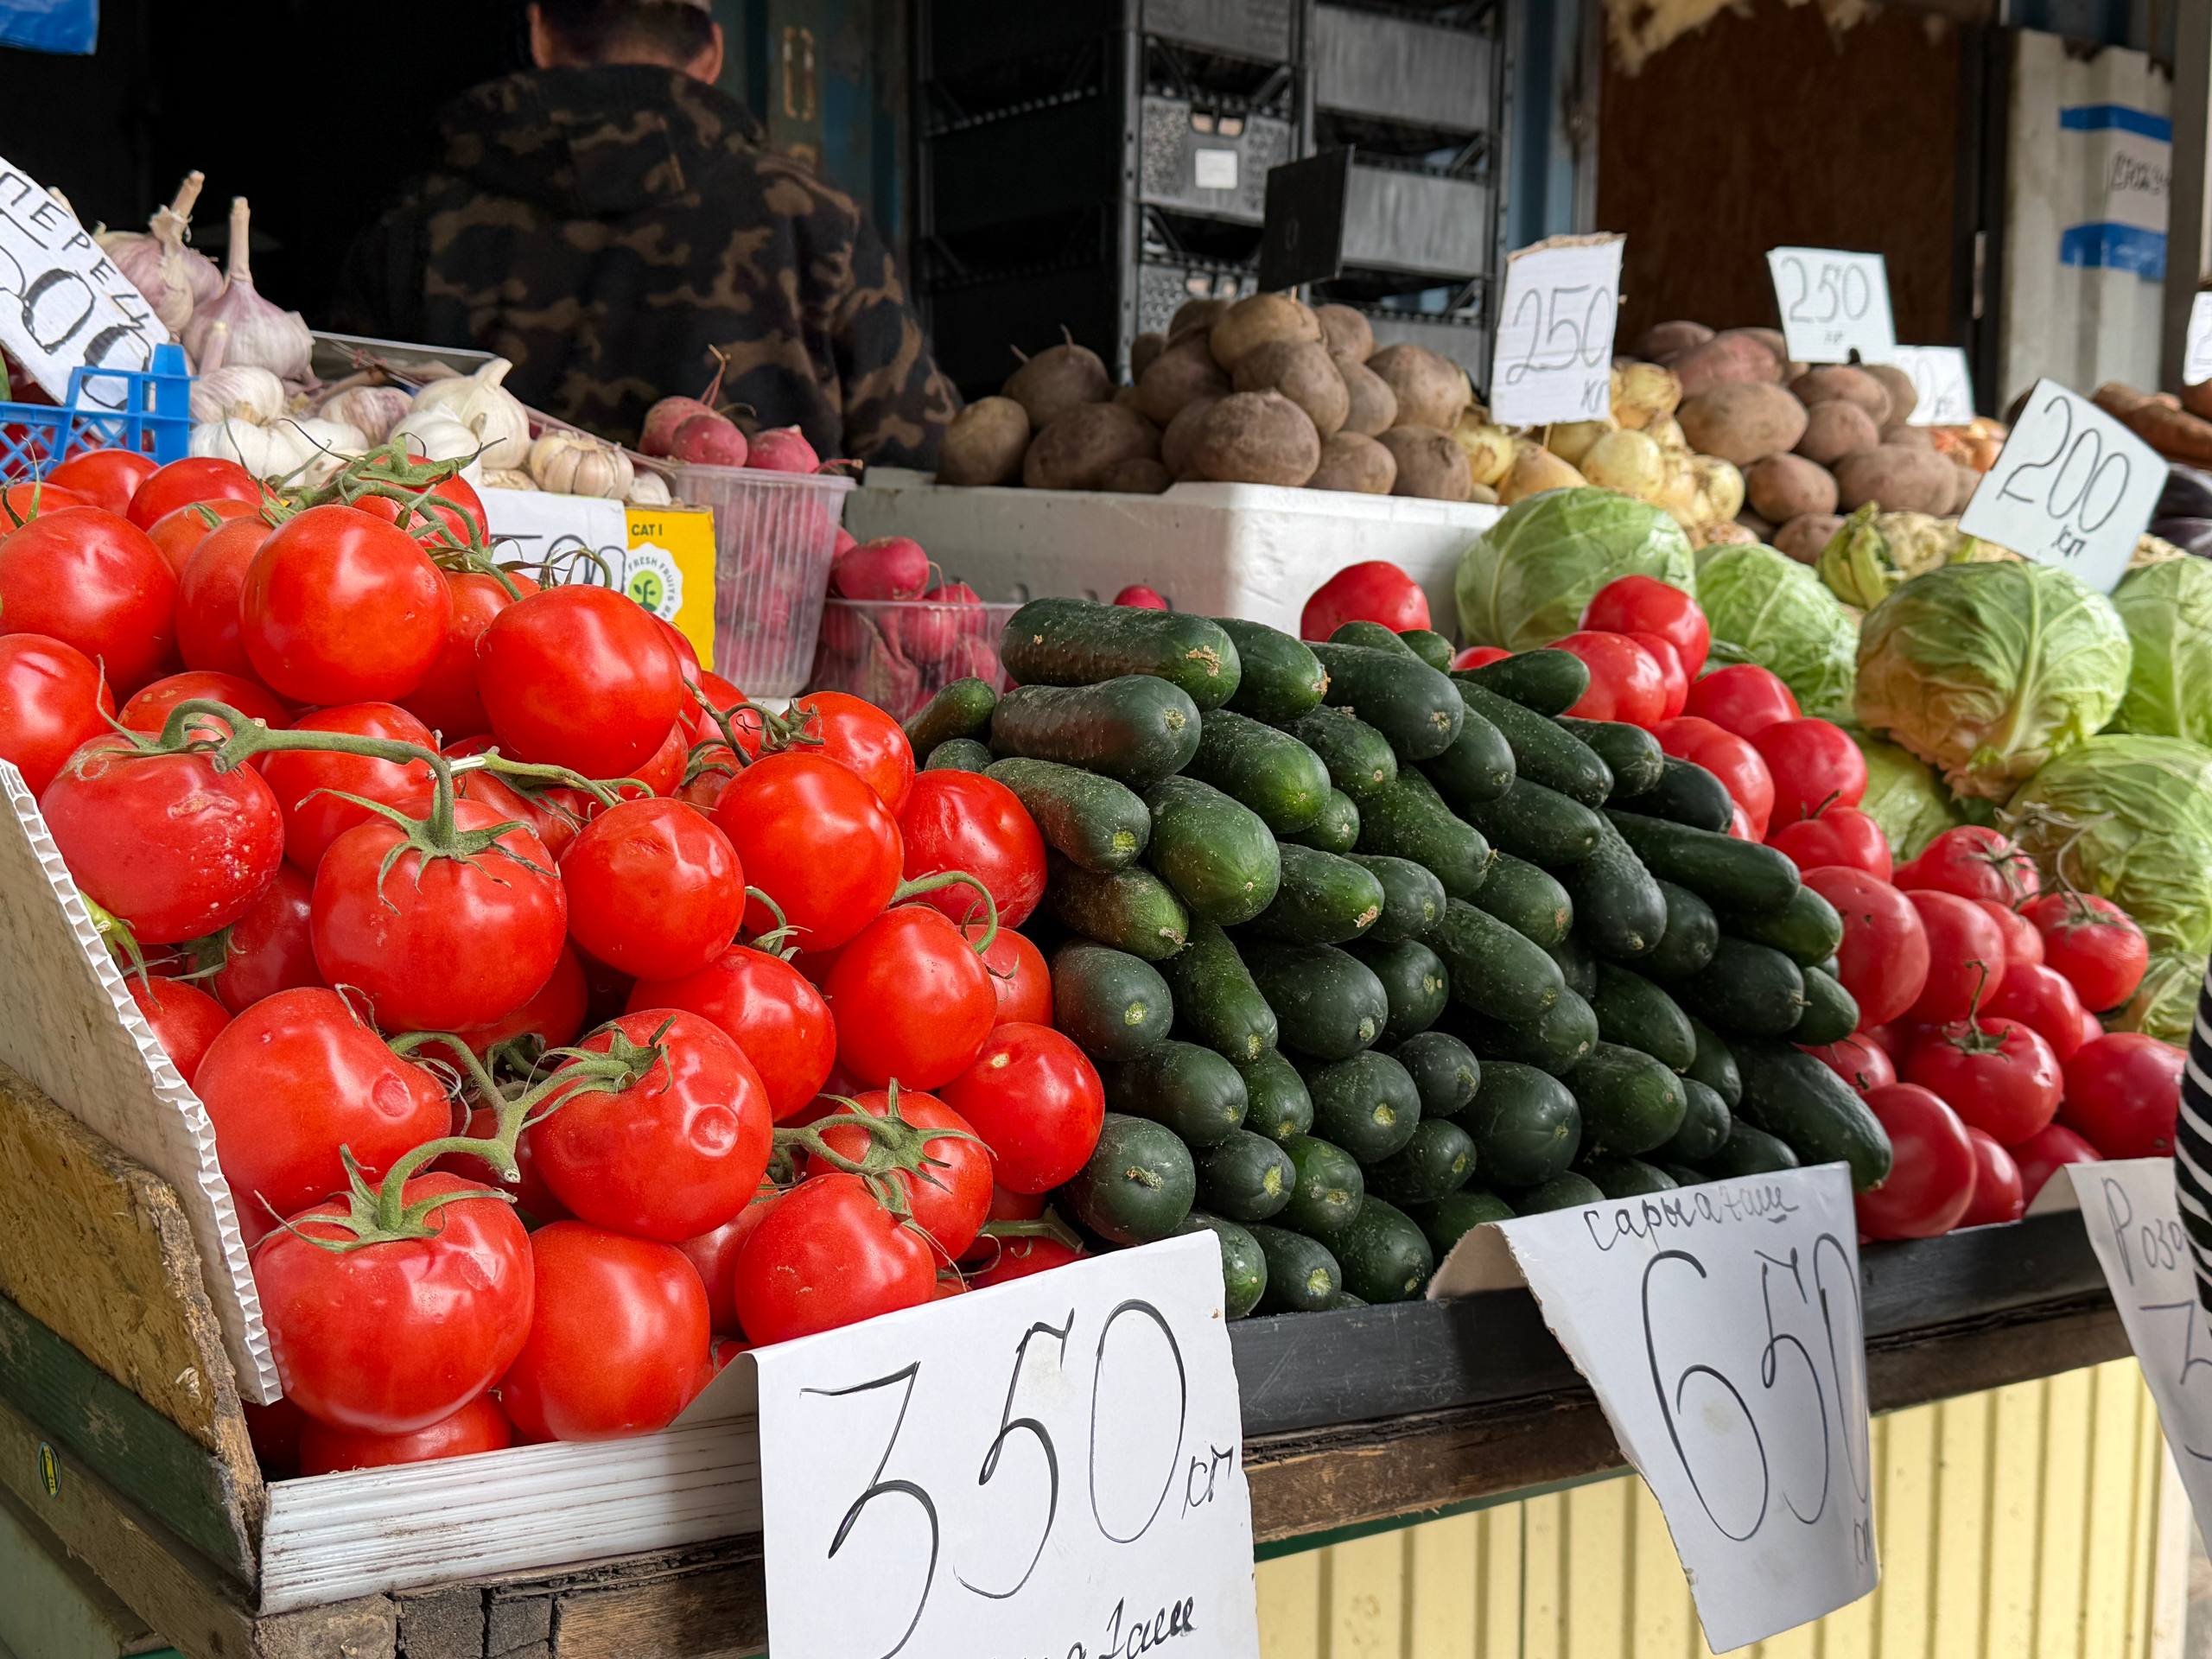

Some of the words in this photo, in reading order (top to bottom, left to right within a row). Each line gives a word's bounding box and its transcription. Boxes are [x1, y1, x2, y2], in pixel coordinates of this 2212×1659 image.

[1505, 283, 1611, 385] 250
[1780, 257, 1871, 322] 250
[1995, 395, 2131, 534] 200
[628, 556, 658, 571] FRESH
[658, 563, 676, 601] FRUITS
[631, 524, 656, 536] CAT
[1643, 1232, 1869, 1541] 650
[799, 1298, 1185, 1659] 350
